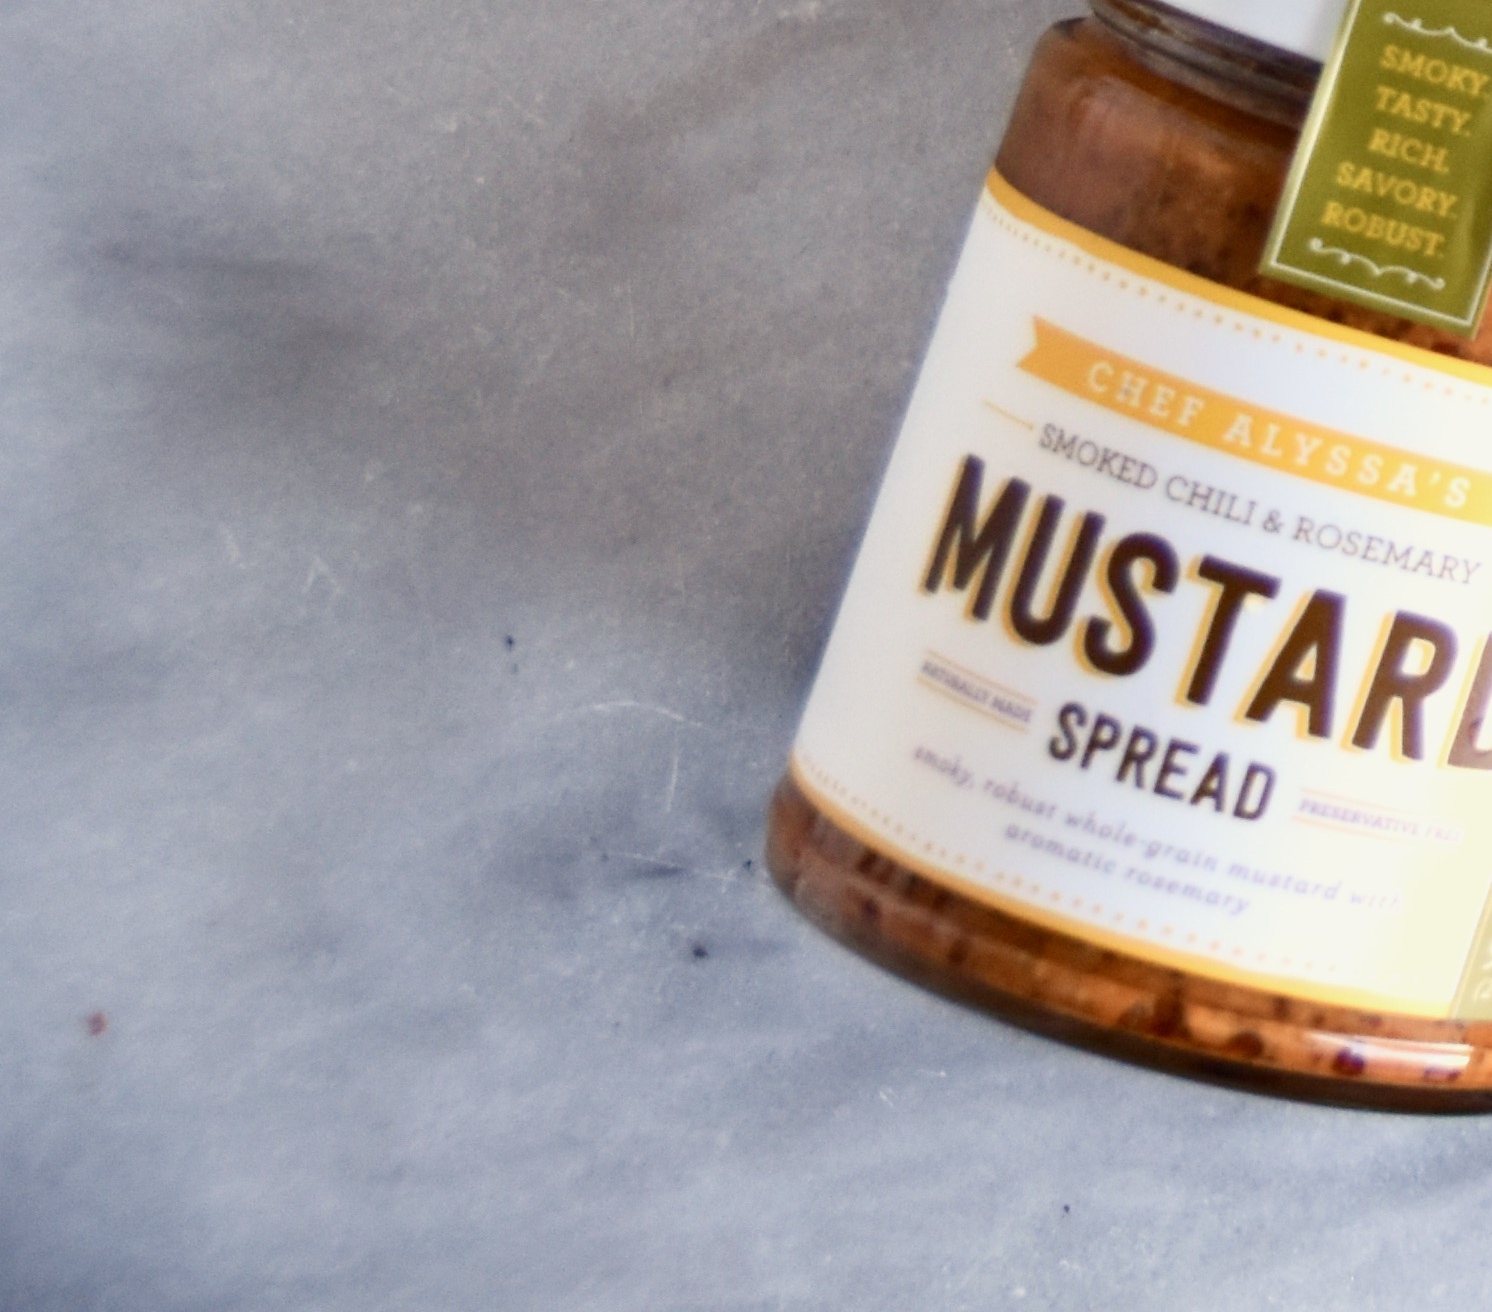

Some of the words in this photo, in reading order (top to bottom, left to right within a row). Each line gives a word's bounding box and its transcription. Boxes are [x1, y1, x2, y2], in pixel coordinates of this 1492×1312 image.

[1379, 43, 1491, 98] SMOKY.
[1373, 84, 1472, 137] TASTY.
[1367, 128, 1450, 175] RICH.
[1335, 161, 1458, 220] SAVORY.
[1320, 200, 1446, 258] ROBUST.
[1087, 360, 1206, 429] CHEF
[1221, 413, 1472, 510] ALYSSA'S
[1038, 422, 1158, 493] SMOKED
[1165, 475, 1256, 527] CHILI
[1261, 509, 1285, 534] &
[1295, 515, 1483, 586] ROSEMARY
[1047, 700, 1277, 822] SPREAD
[982, 777, 1058, 819] robust
[1227, 861, 1344, 902] mustard
[1299, 797, 1420, 837] PRESERVATIVE
[1003, 823, 1118, 876] aromatic
[1123, 867, 1251, 917] rosemary
